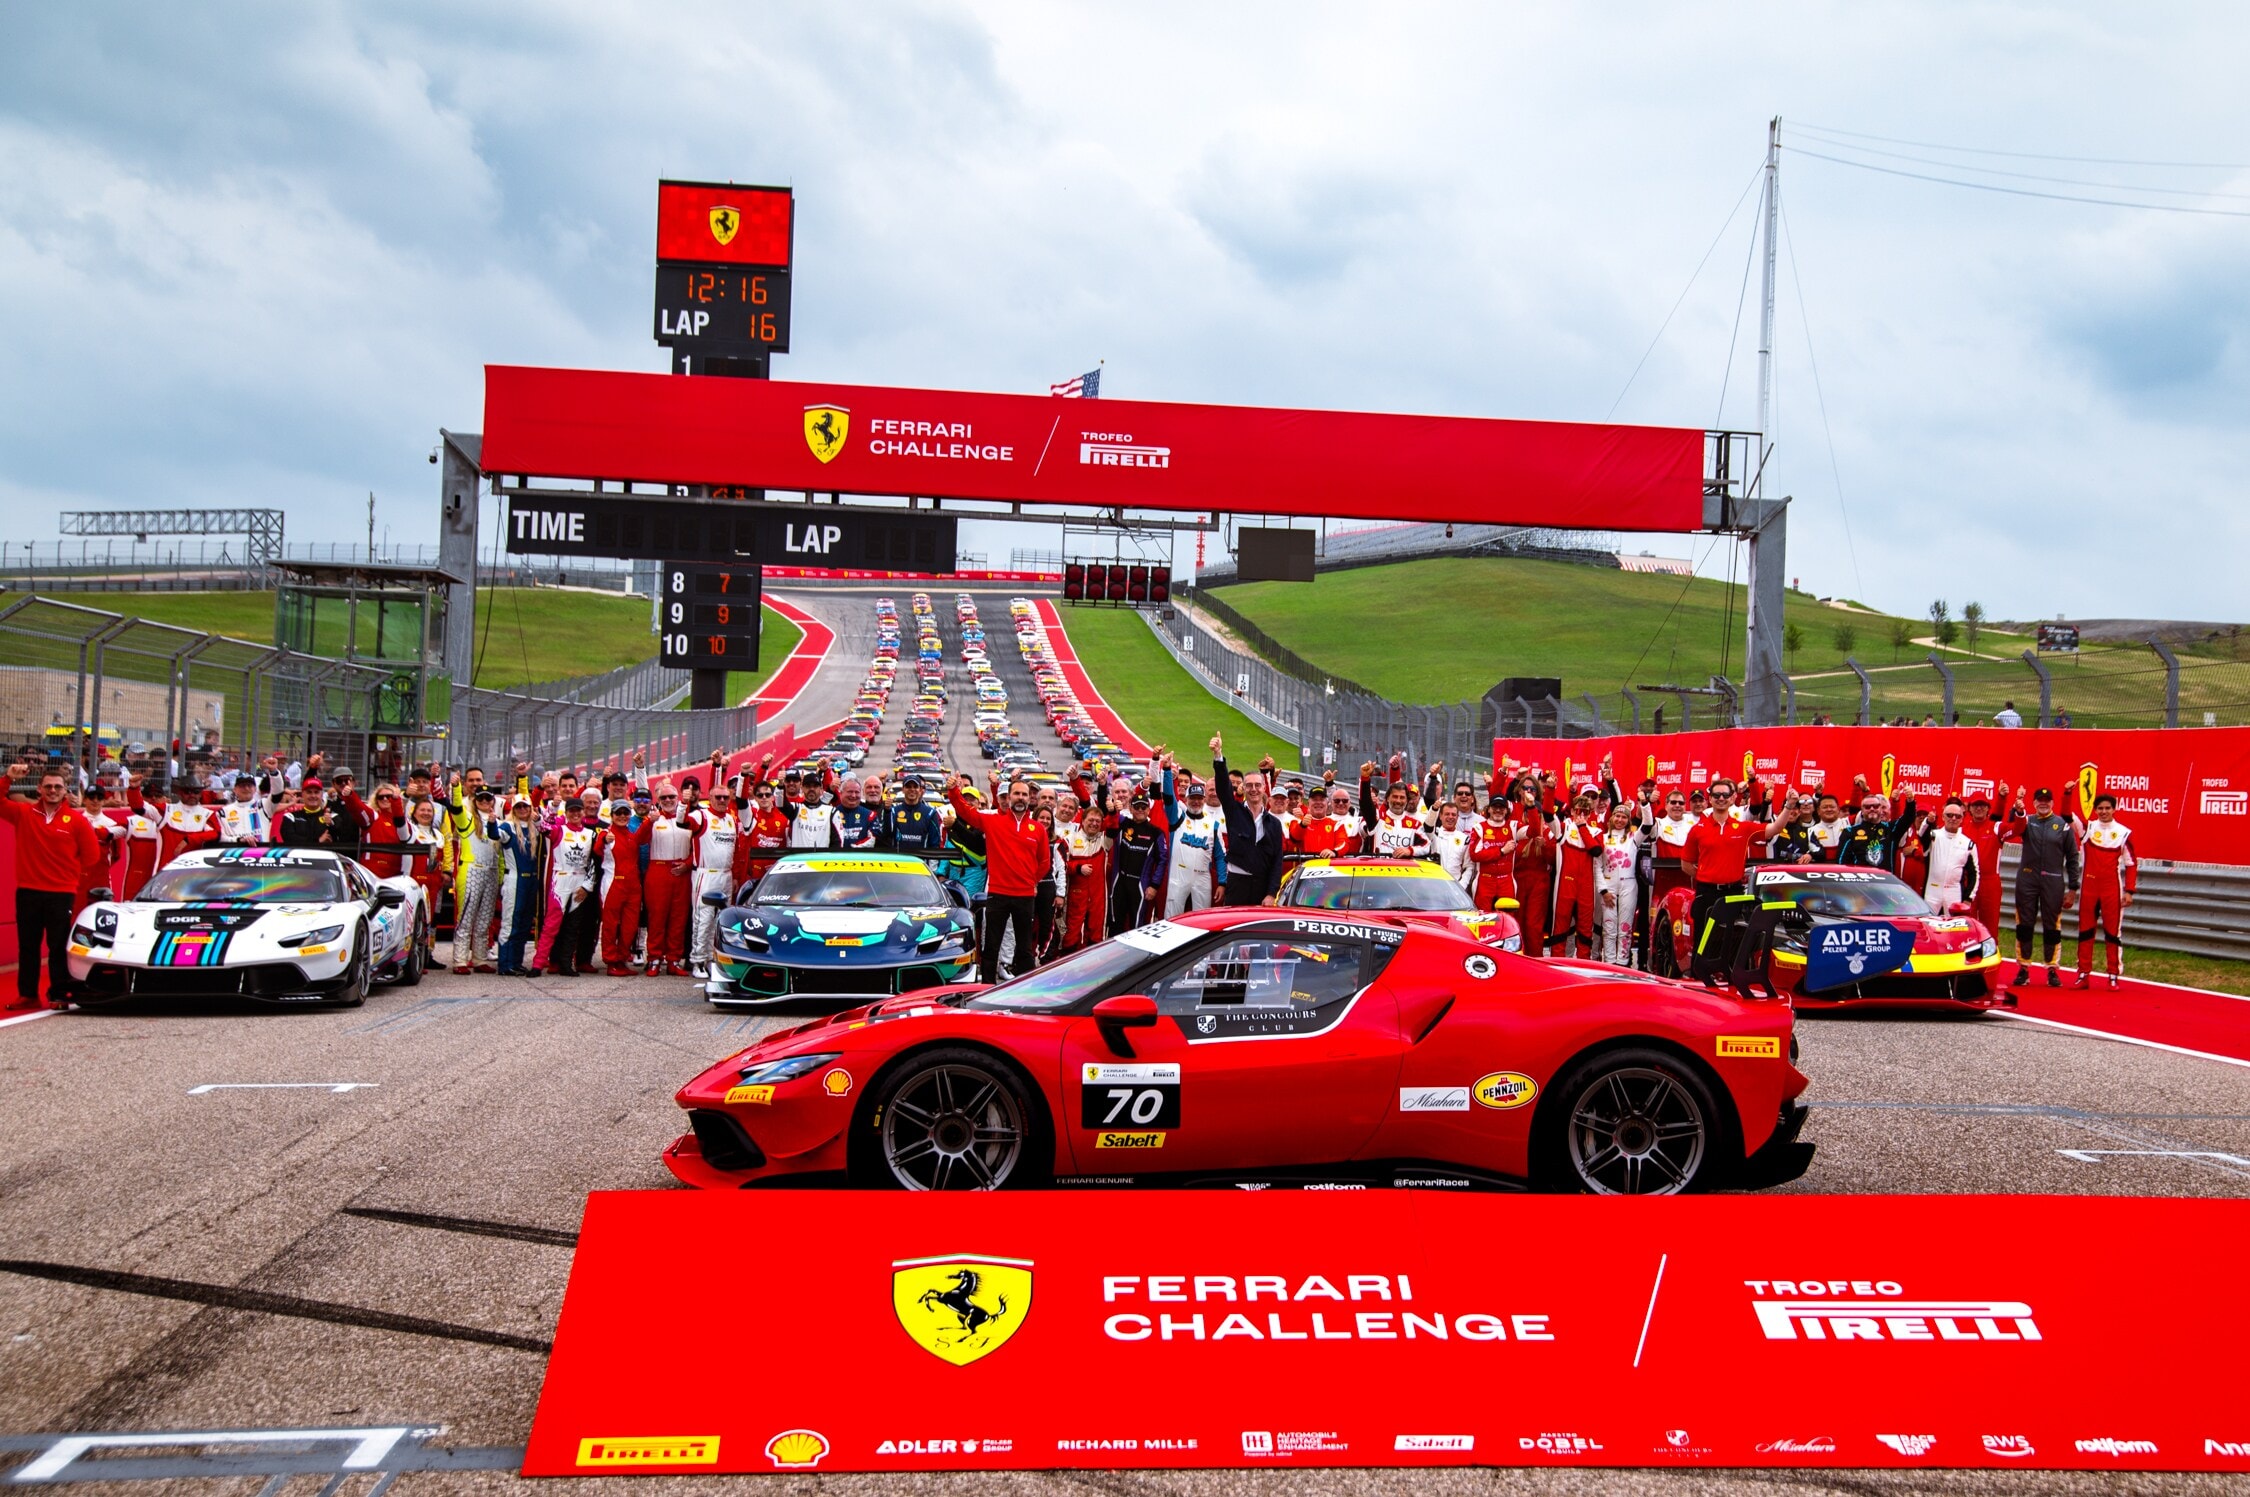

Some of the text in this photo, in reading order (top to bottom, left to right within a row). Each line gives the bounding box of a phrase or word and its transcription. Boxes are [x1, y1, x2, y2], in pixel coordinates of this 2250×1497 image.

[688, 273, 767, 305] 12:16
[661, 309, 776, 341] LAP 16
[871, 419, 972, 438] FERRARI
[1081, 432, 1133, 442] TROFEO
[870, 440, 1013, 461] CHALLENGE
[1080, 443, 1171, 468] PIRELLI
[512, 511, 585, 542] TIME
[786, 523, 842, 554] LAP
[672, 572, 685, 593] 8
[720, 575, 730, 593] 7
[671, 603, 684, 623] 9
[718, 606, 729, 624] 9
[663, 634, 688, 655] 10
[708, 637, 725, 654] 10
[1899, 764, 1930, 777] FERRARI
[2105, 775, 2149, 791] FERRARI
[2202, 779, 2228, 787] TROFEO
[2200, 791, 2248, 815] PIRELLI
[1382, 832, 1411, 847] octa
[219, 857, 313, 865] DOBEL
[1807, 872, 1885, 880] DOBEL
[1293, 920, 1371, 939] PERONI
[1823, 929, 1892, 946] ADLER
[1224, 1010, 1317, 1021] THE CONCOURS
[1722, 1040, 1775, 1054] PIRELLI
[728, 1089, 770, 1102] PIRELLI
[1483, 1081, 1528, 1099] PENNZOIL
[1102, 1089, 1163, 1124] 70
[1103, 1134, 1158, 1147] Sabelt
[1394, 1179, 1470, 1187] @FerrariRaces
[1103, 1275, 1412, 1301] FERRARI
[1744, 1280, 1903, 1295] TROFEO
[1103, 1312, 1555, 1342] CHALLENGE
[1752, 1301, 2042, 1340] PIRELLI
[1277, 1431, 1338, 1439] AUTOMOBILE
[1404, 1437, 1464, 1449] Sabelt
[1519, 1438, 1603, 1449] DOBEL
[1981, 1435, 2029, 1448] aws
[590, 1441, 707, 1459] PIRELLI
[876, 1440, 957, 1454] ADLER
[1057, 1438, 1198, 1450] RICHARD MILLE
[2075, 1437, 2159, 1456] rotiform
